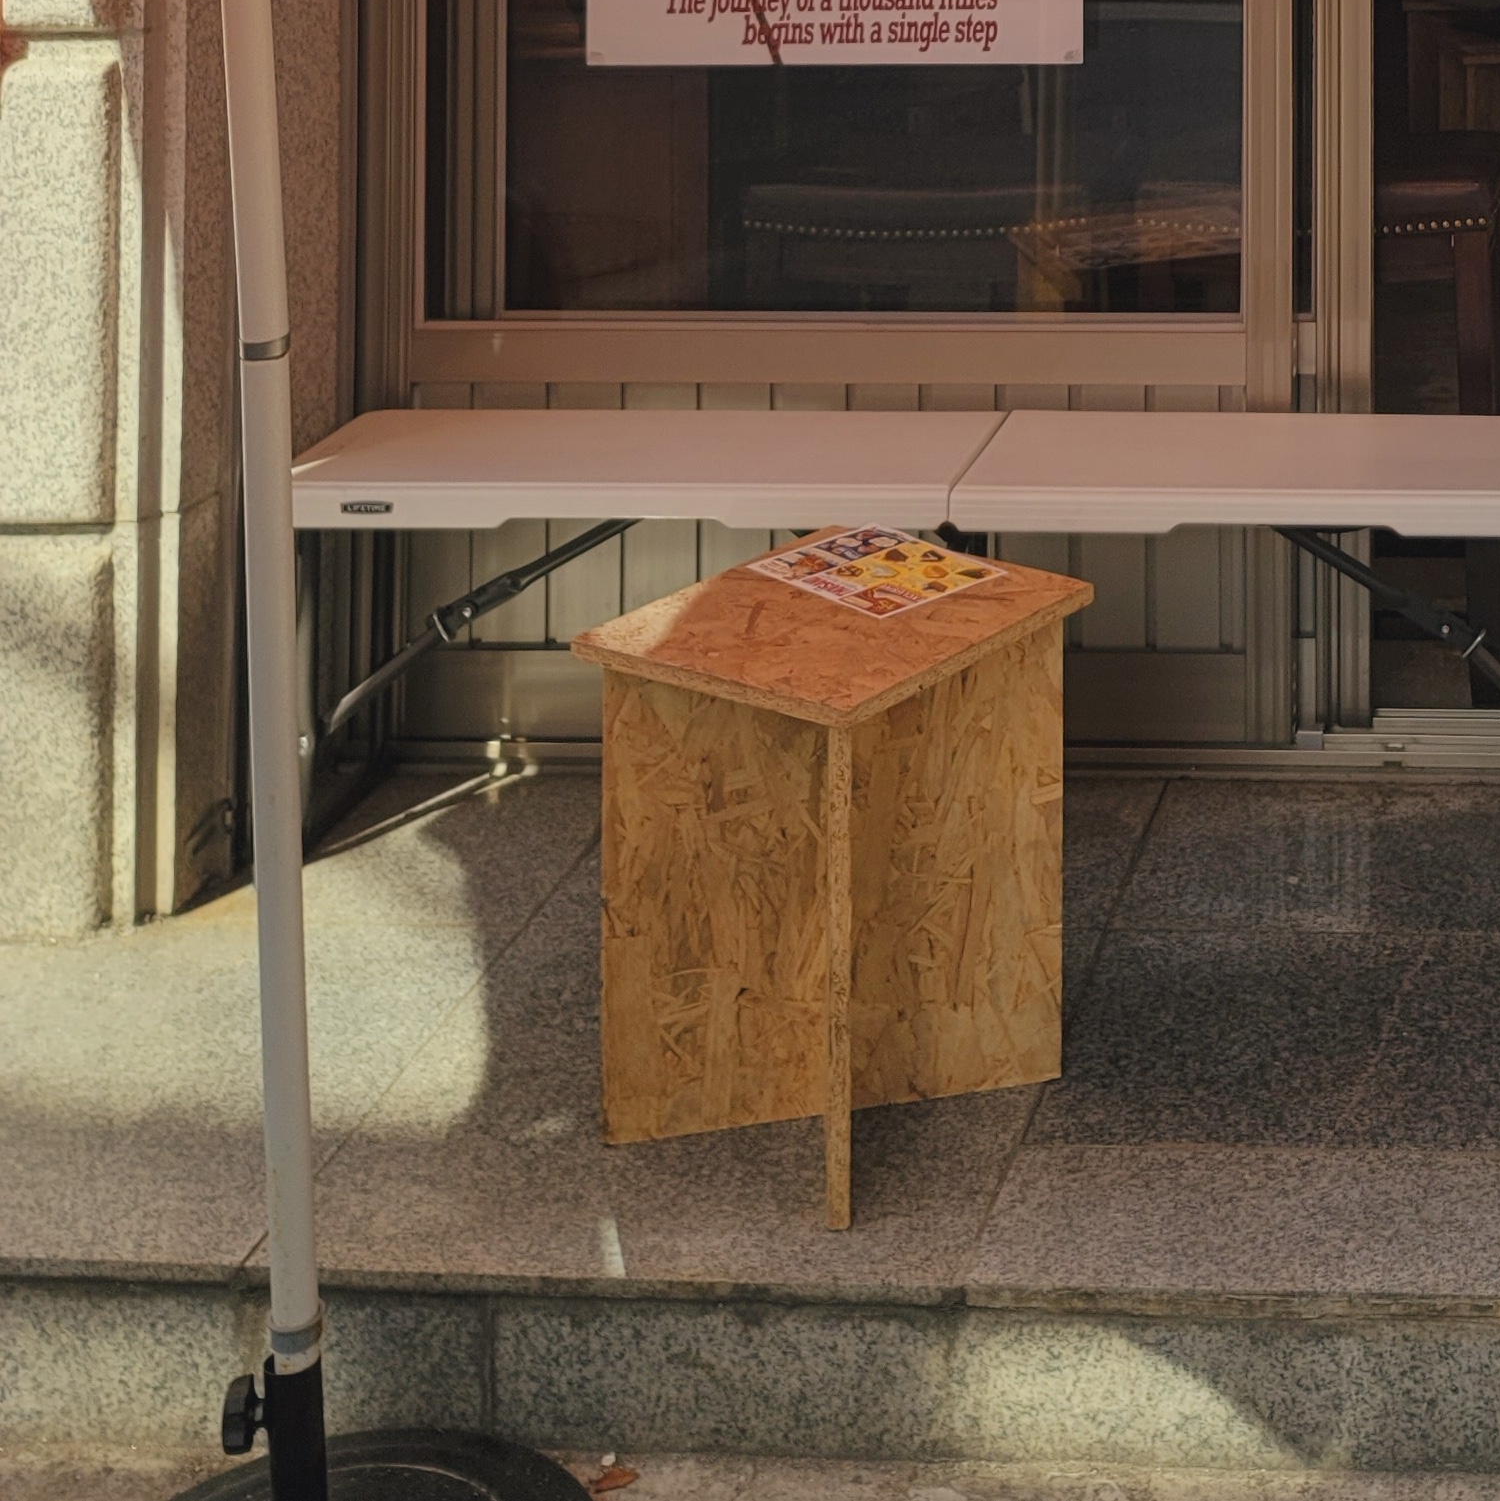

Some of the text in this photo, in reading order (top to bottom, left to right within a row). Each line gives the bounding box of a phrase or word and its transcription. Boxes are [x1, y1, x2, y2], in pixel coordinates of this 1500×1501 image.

[742, 13, 998, 52] begins with a single step
